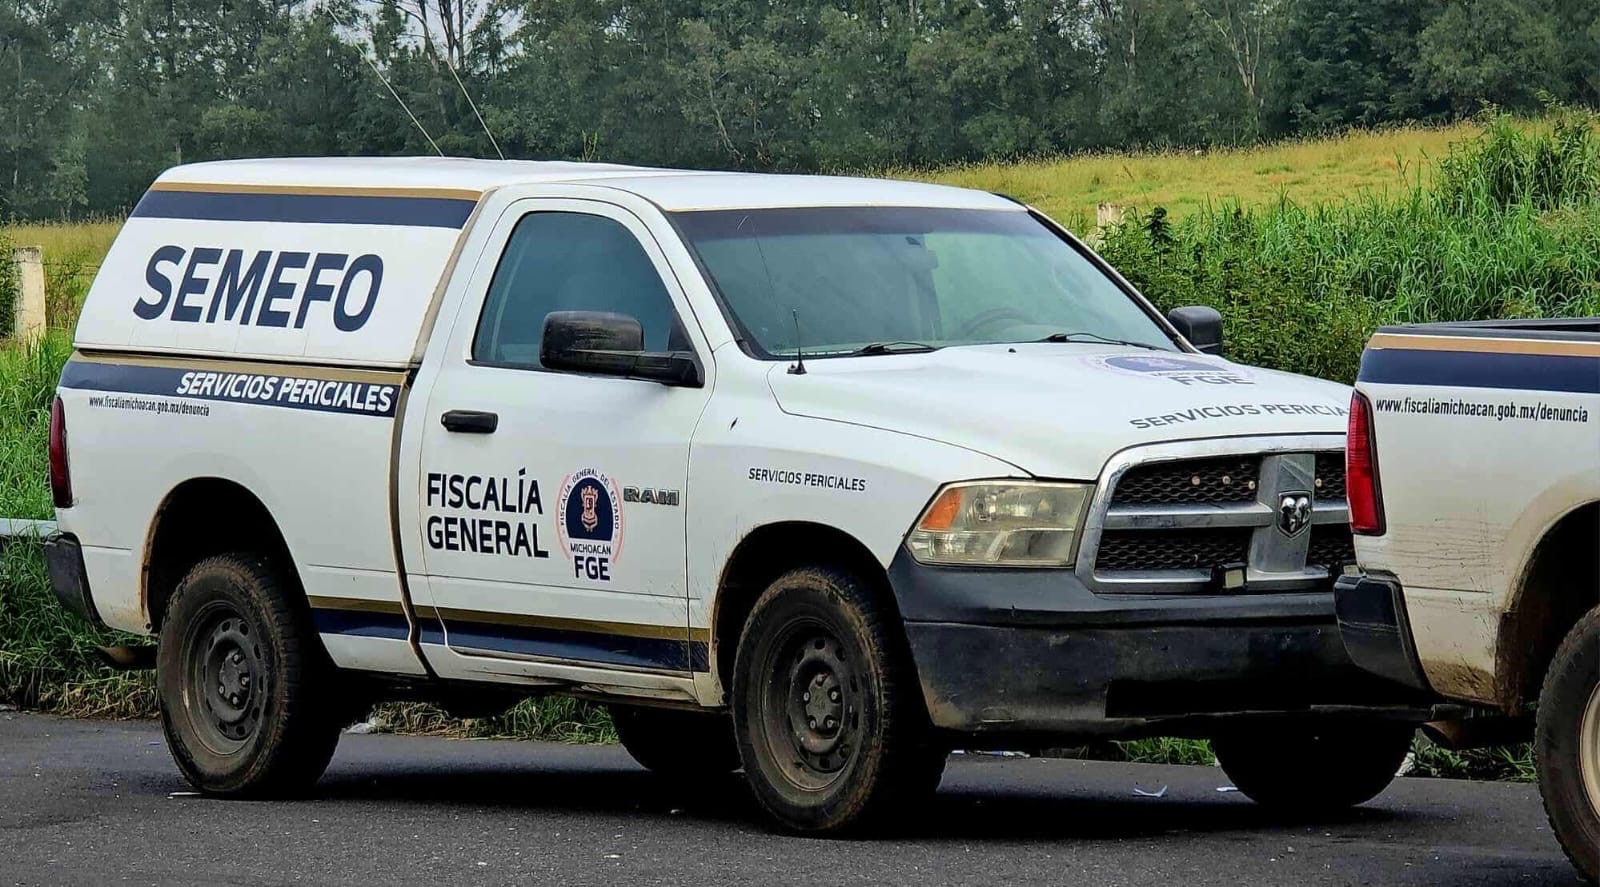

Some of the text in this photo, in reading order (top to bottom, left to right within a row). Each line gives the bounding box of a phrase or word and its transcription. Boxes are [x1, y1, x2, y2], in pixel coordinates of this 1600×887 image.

[133, 244, 384, 332] SEMEFO
[176, 371, 394, 413] SERVICIOS PERICIALES
[1168, 375, 1256, 386] FGE
[88, 396, 210, 417] www.fiscaliamichoacan.gob.mx/denuncia
[1130, 404, 1349, 429] SERVICIOS PERICIA
[1376, 397, 1588, 422] www.fiscaliamichoacan.gob.mx/denuncia
[572, 467, 598, 483] GENERAL
[600, 473, 610, 488] DEL
[748, 467, 866, 492] SERVICIOS PERICIALES
[428, 467, 543, 515] FISCALÍA
[623, 486, 680, 506] RAM
[427, 516, 549, 559] GENERAL
[574, 555, 610, 581] FGE
